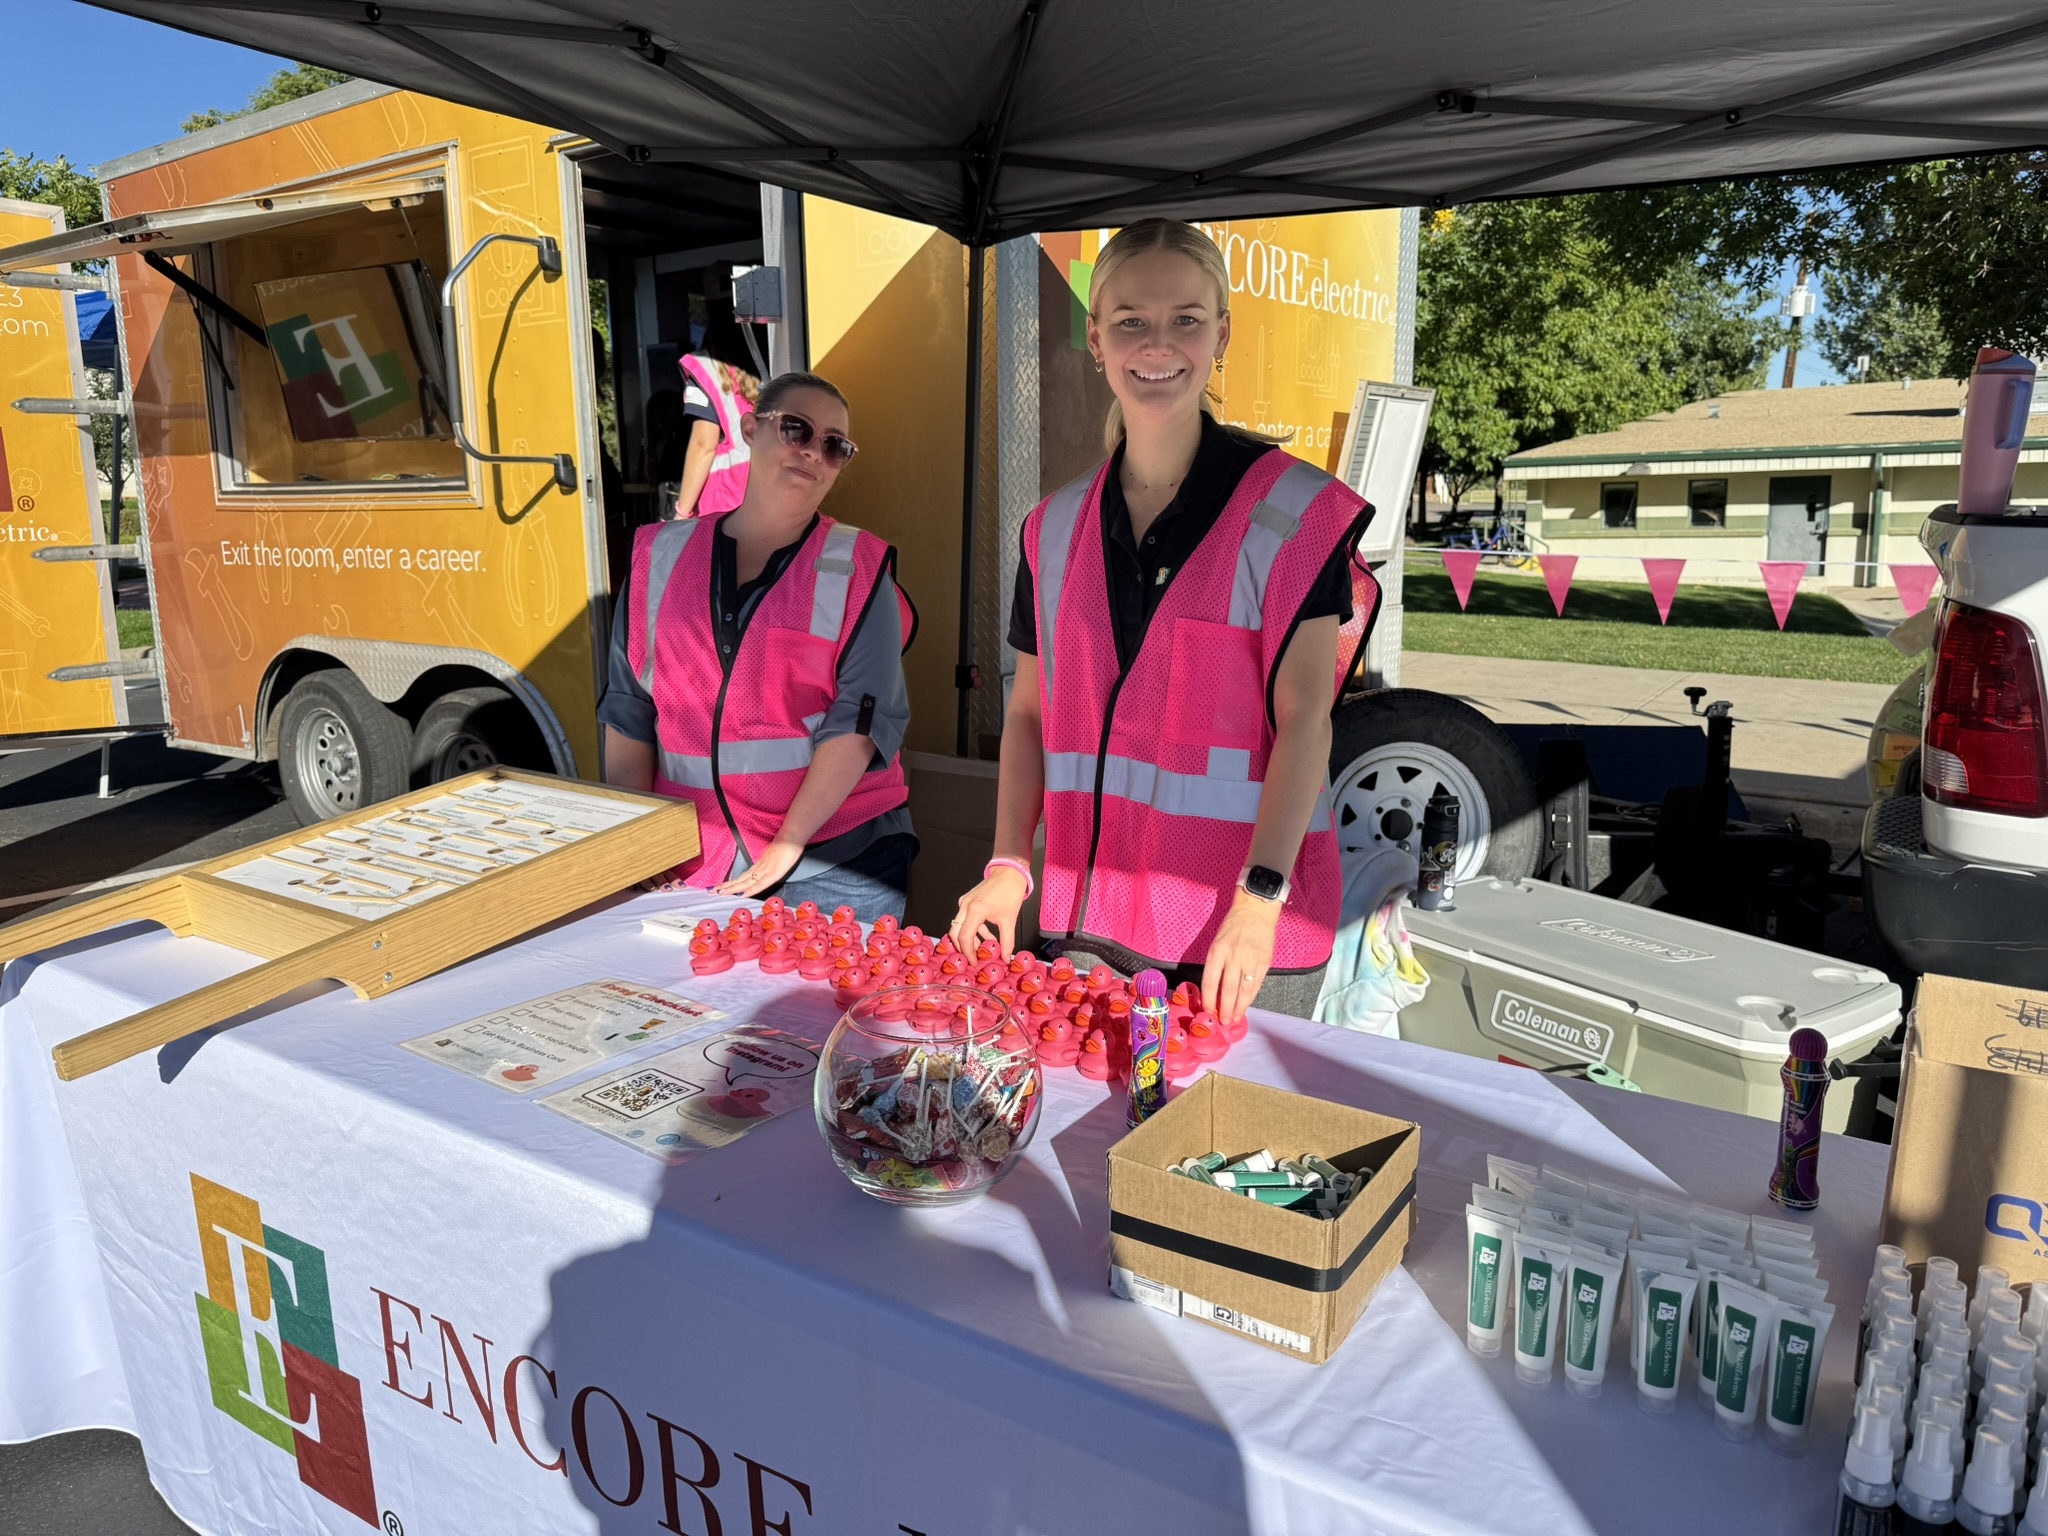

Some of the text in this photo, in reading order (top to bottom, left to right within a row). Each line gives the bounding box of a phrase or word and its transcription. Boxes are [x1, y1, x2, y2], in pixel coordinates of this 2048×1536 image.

[0, 317, 49, 337] om
[220, 540, 487, 573] Exit the room, enter a career.
[638, 992, 704, 1017] Checklist
[1503, 999, 1581, 1044] Coleman
[482, 1030, 567, 1063] Get Mary's Business Card
[545, 1035, 569, 1046] Social
[566, 1042, 589, 1055] Media
[724, 1046, 791, 1072] Instagram!
[771, 1054, 788, 1064] us
[786, 1060, 805, 1069] on
[369, 1286, 813, 1536] ENCORE
